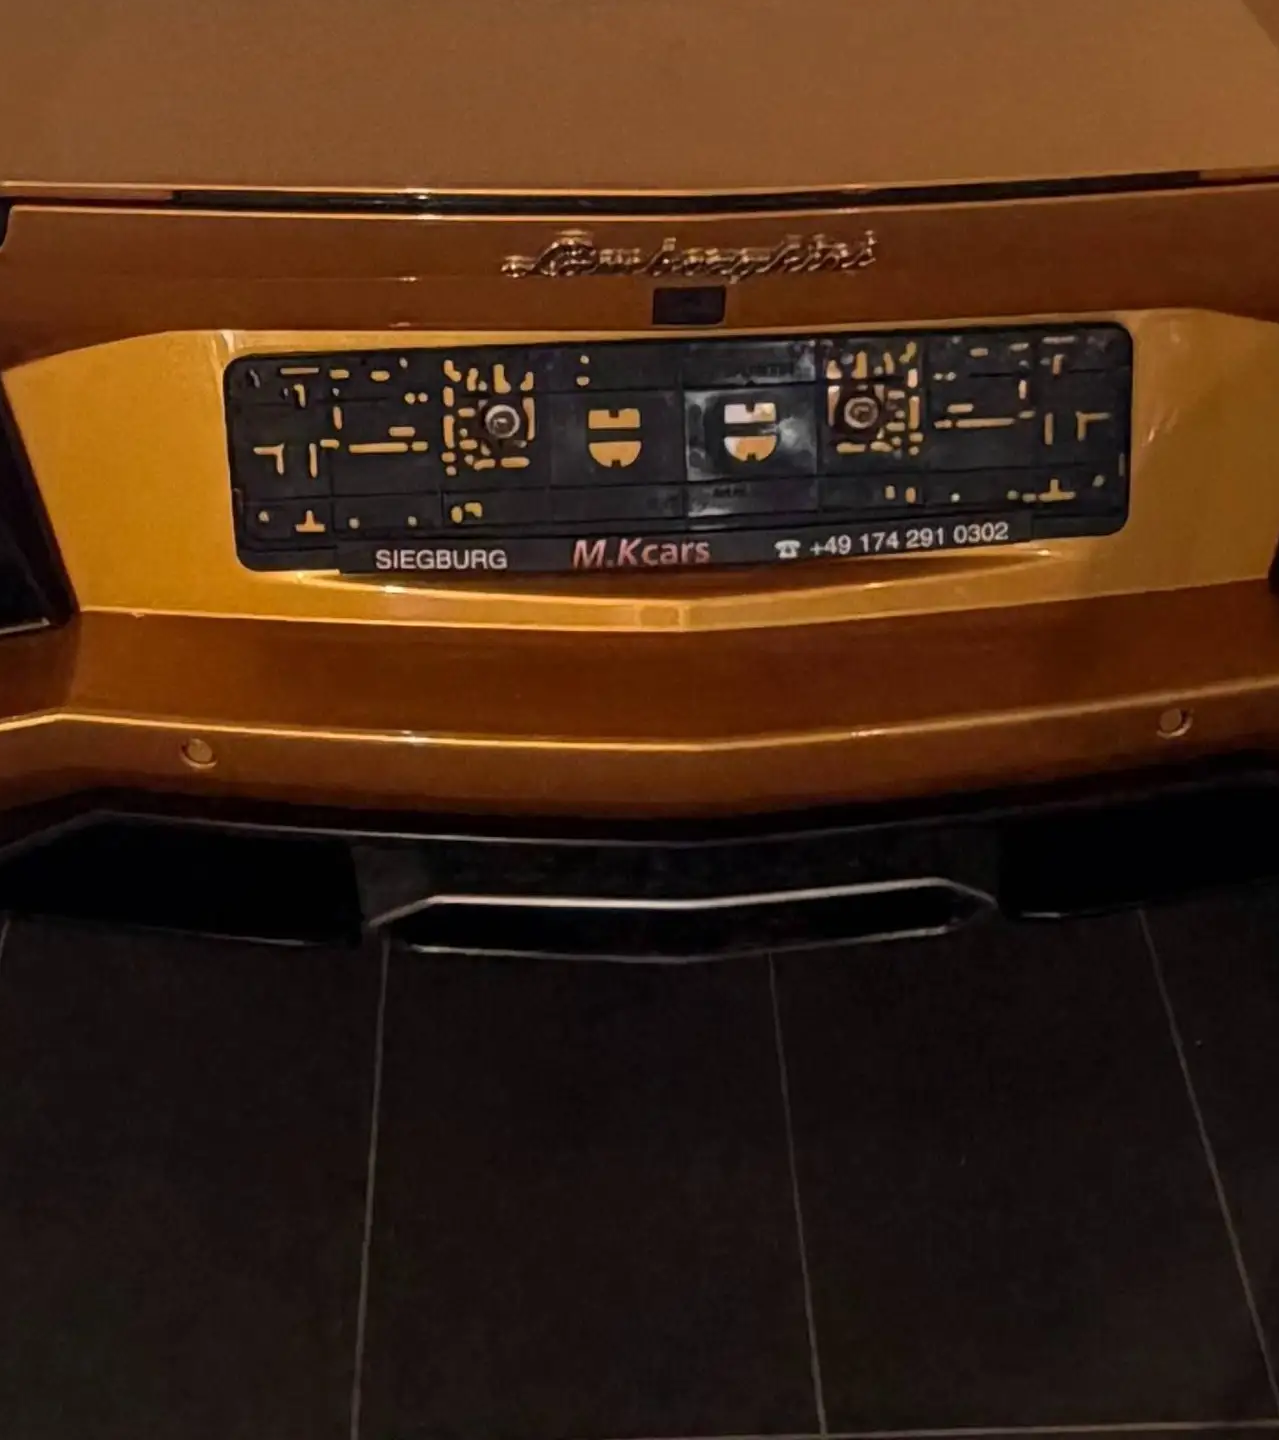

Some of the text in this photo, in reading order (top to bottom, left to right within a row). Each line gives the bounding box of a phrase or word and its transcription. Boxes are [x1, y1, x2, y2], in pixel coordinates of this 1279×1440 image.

[375, 521, 1009, 571] SIEGBURG M.Kcars +49 174 291 0302
